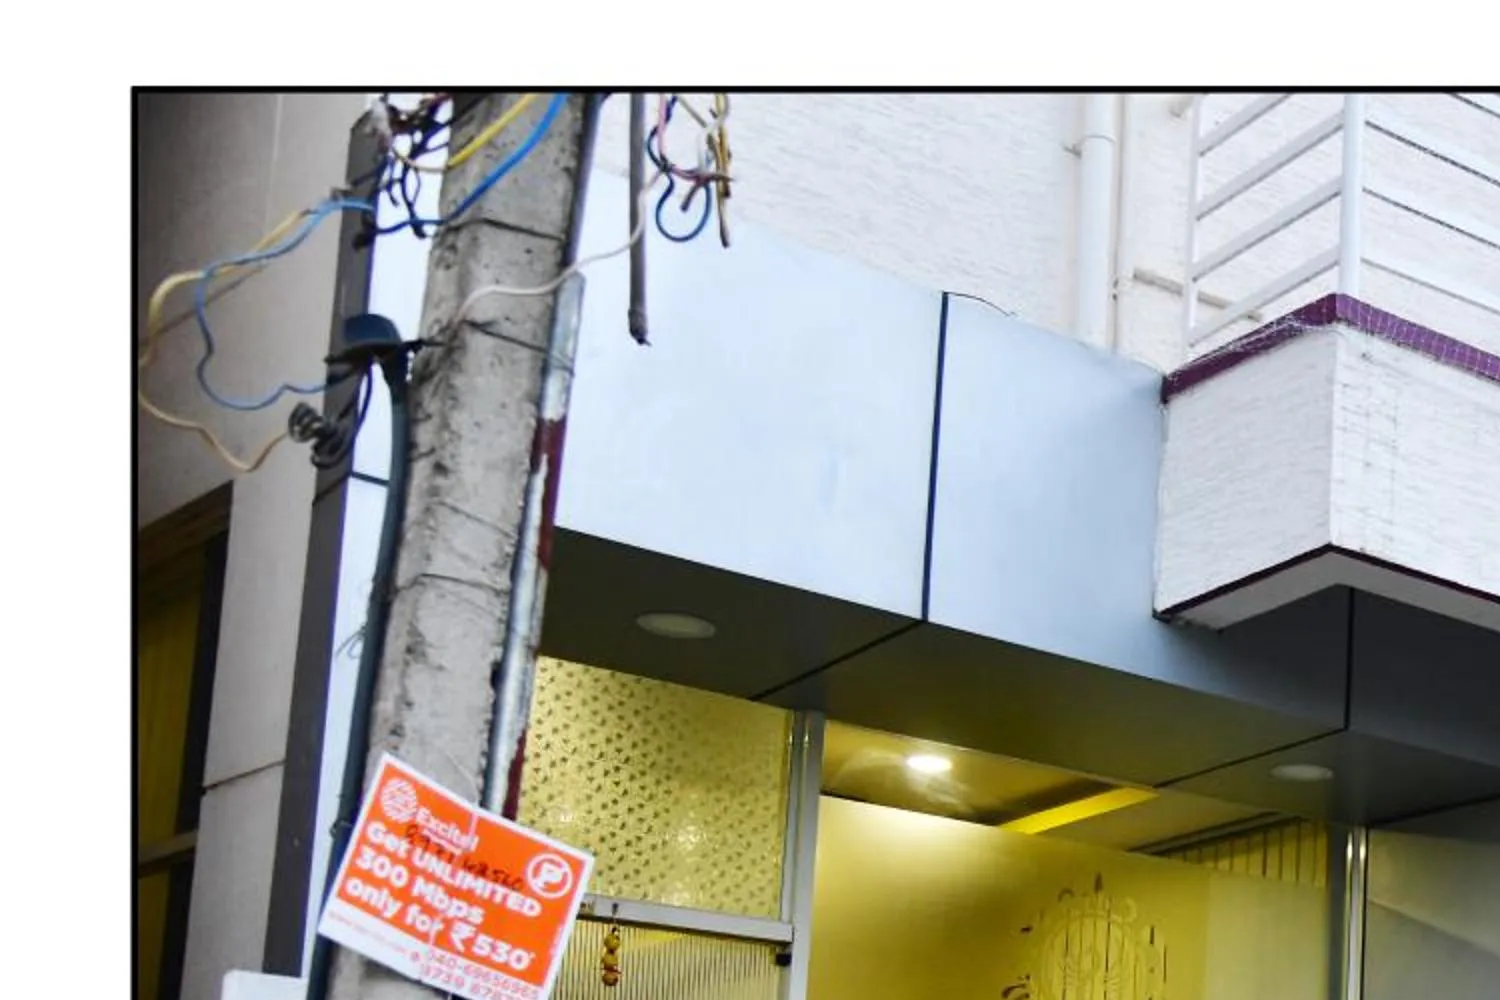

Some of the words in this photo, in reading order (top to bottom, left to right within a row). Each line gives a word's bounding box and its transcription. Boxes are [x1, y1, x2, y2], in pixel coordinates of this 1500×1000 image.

[346, 877, 402, 919] only
[405, 903, 445, 935] for
[356, 847, 409, 887] 300
[412, 875, 485, 924] Mbps
[366, 821, 409, 856] Get
[411, 848, 543, 917] UNLIMITED
